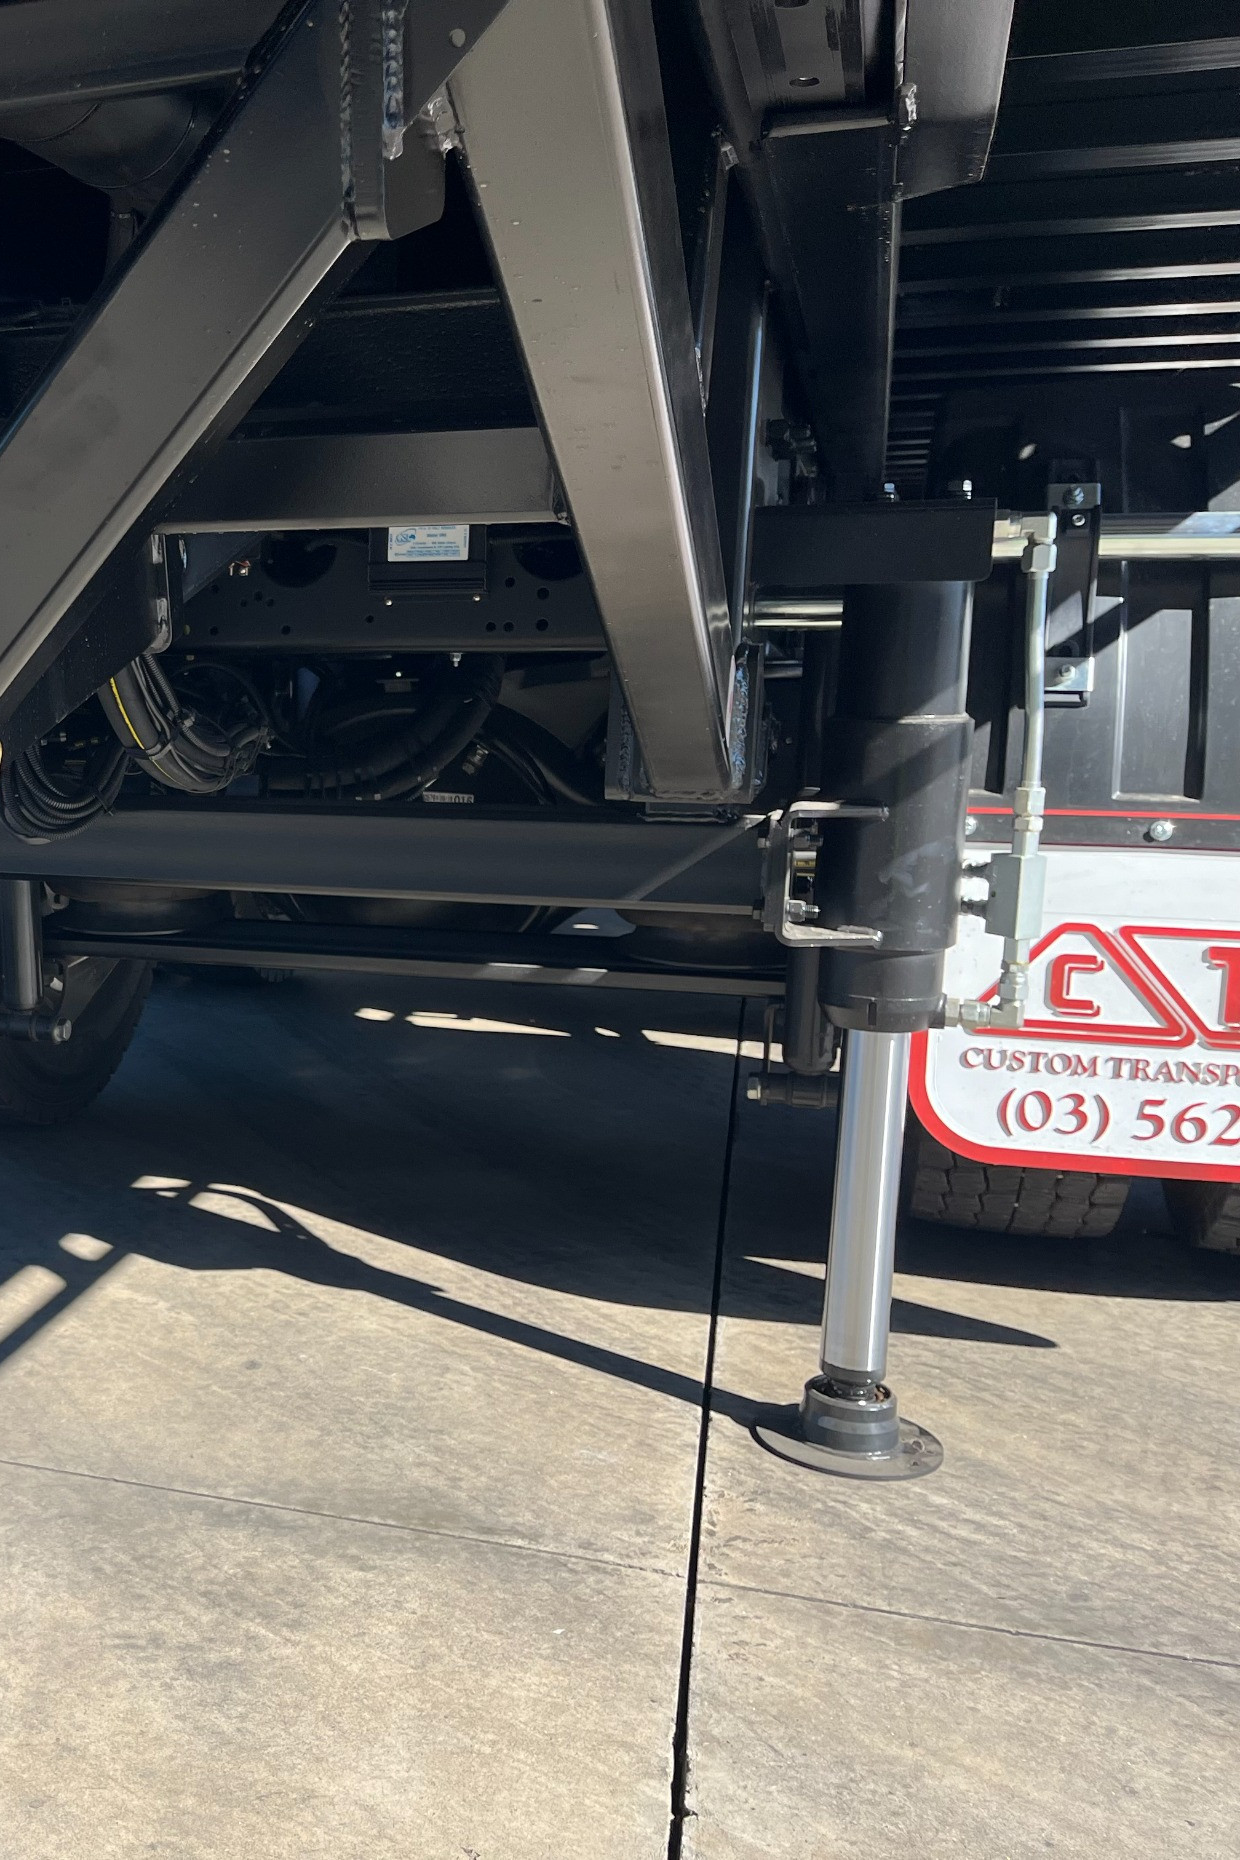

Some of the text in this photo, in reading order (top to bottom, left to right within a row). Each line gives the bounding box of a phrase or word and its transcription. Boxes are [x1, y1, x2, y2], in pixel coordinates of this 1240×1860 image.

[960, 1047, 1101, 1078] CUSTOM
[997, 1087, 1240, 1147] (03) 562
